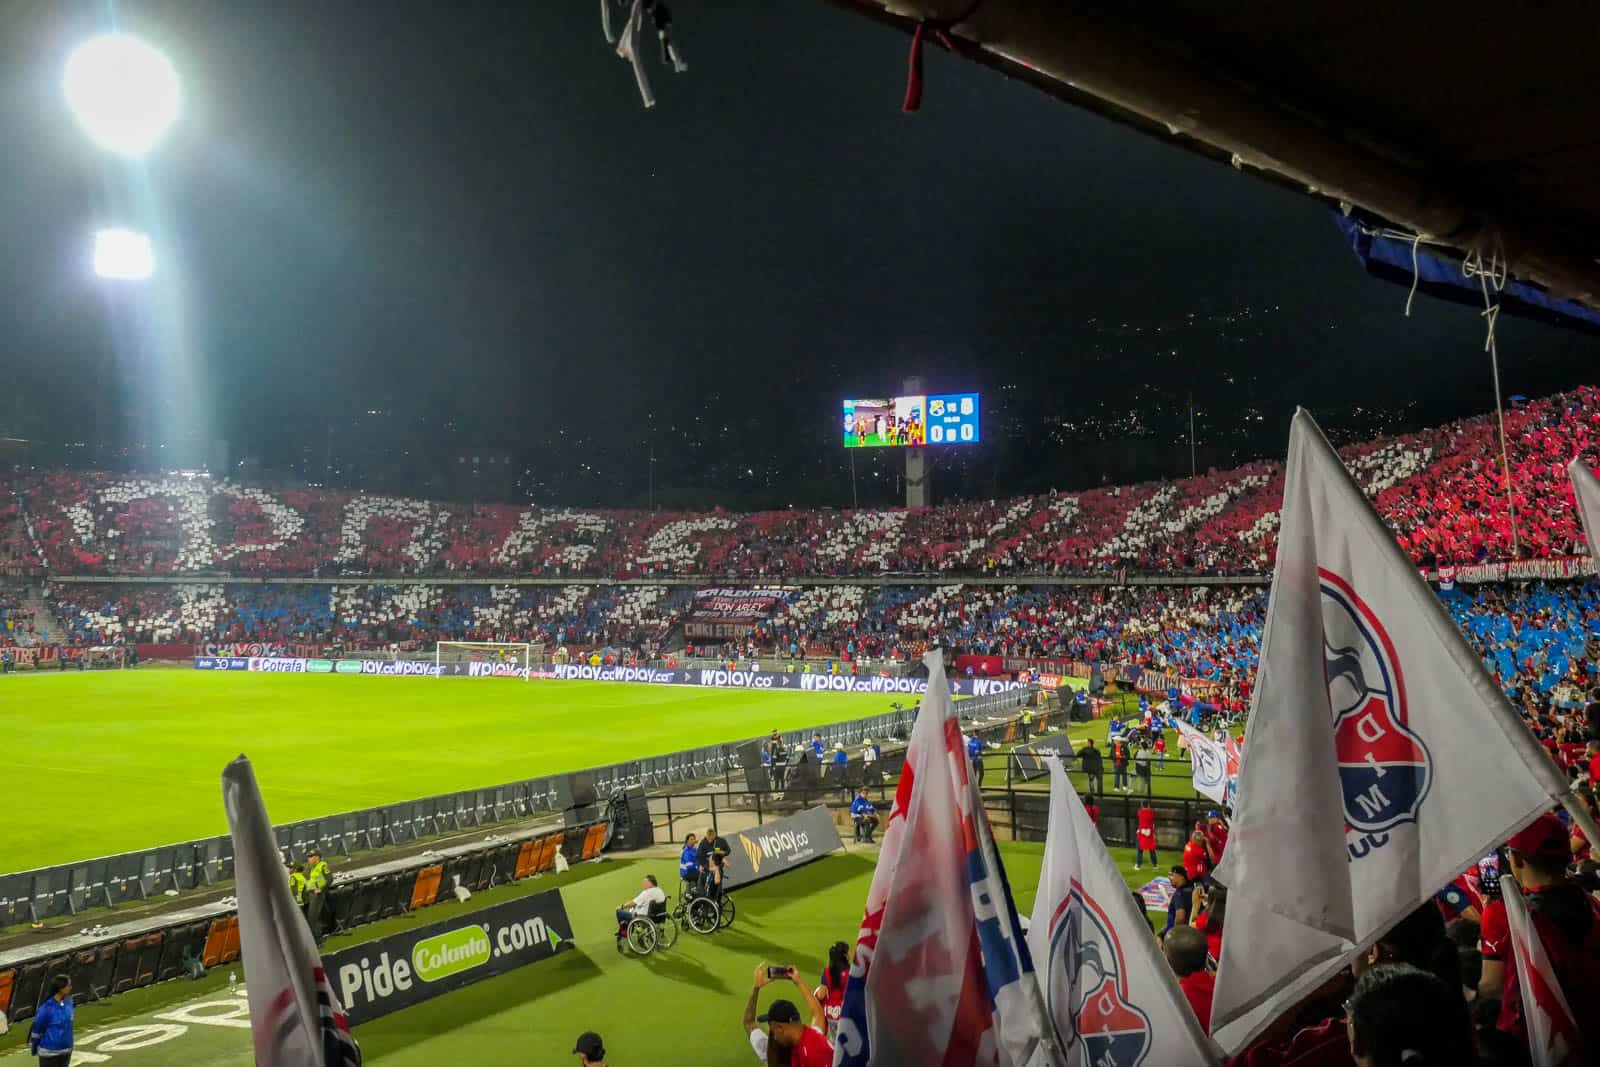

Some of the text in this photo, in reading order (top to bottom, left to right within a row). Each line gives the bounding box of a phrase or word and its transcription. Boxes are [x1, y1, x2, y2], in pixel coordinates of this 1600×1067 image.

[262, 659, 302, 672] Cotrafa
[700, 670, 774, 688] Wplay.co
[758, 830, 809, 859] Wplay.co
[339, 916, 548, 1009] Pide Colanta .com
